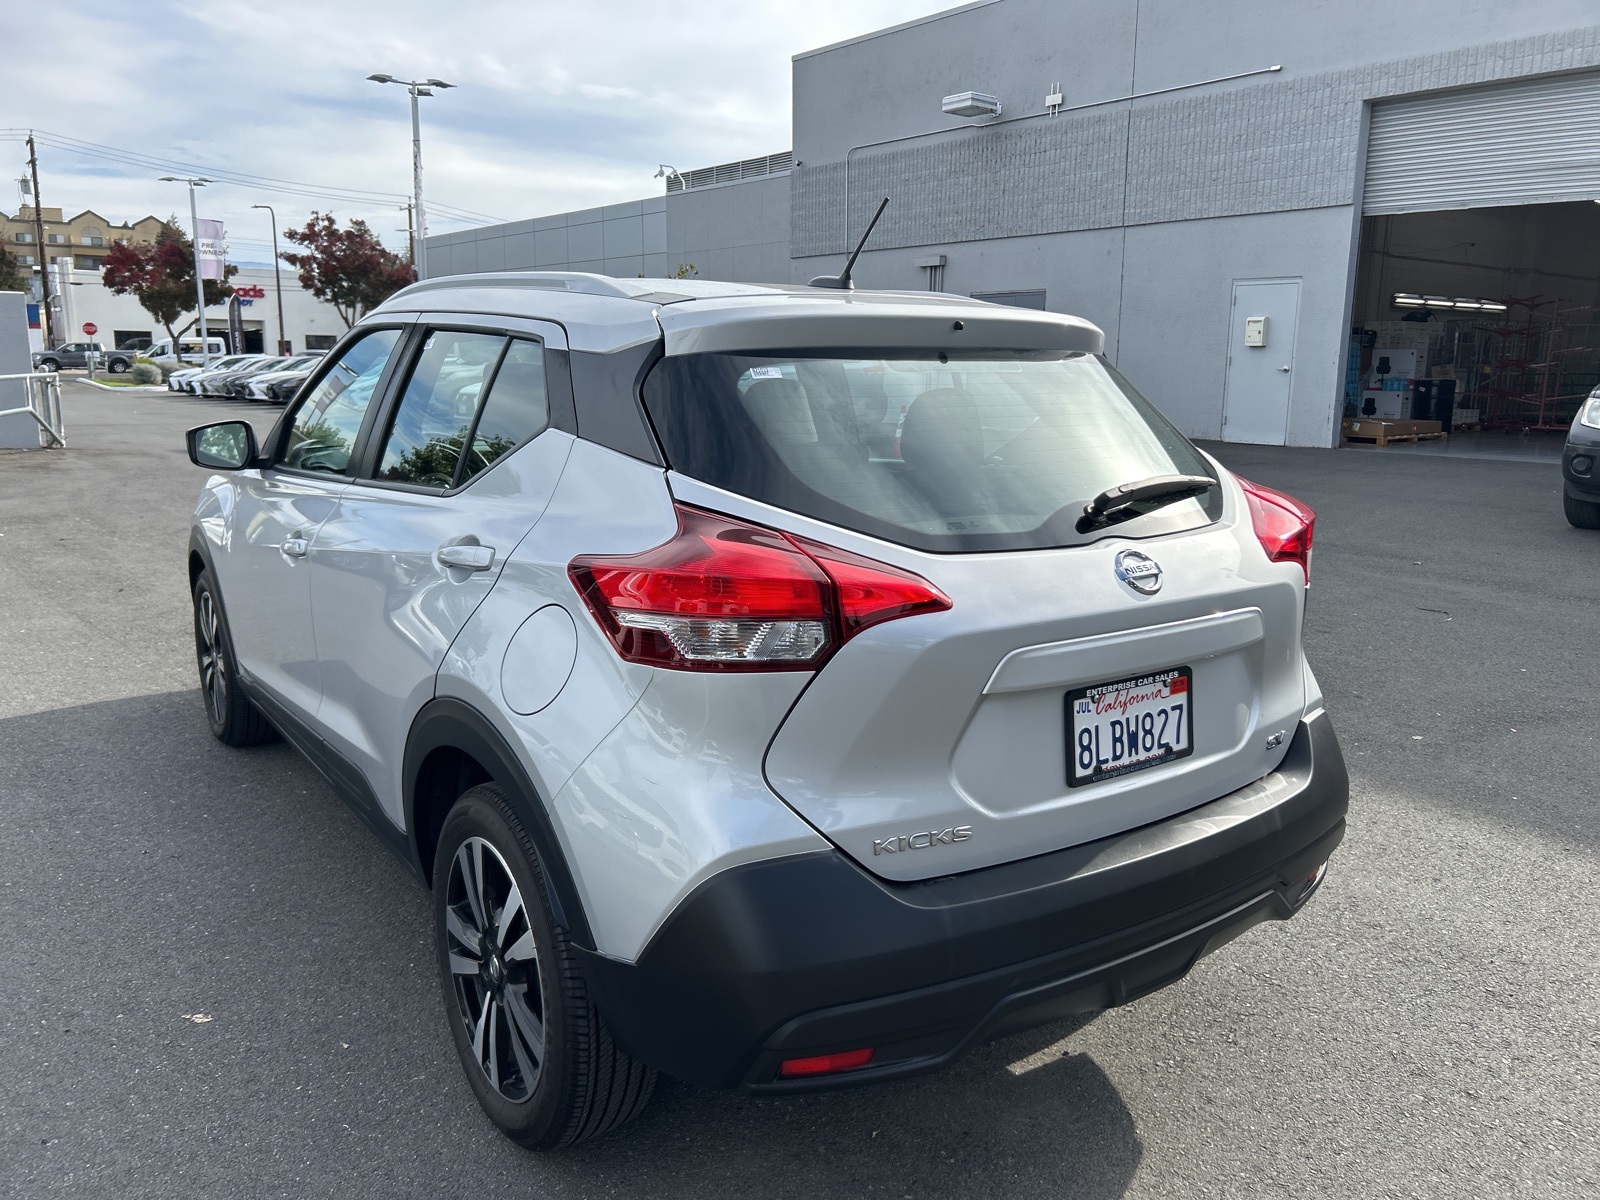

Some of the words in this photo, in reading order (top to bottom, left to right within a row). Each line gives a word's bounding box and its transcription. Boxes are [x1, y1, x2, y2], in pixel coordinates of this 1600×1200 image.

[234, 285, 265, 298] ads
[1086, 682, 1136, 697] ENTERPRISE
[1137, 677, 1153, 686] CAR
[1154, 671, 1179, 682] SALES
[1076, 700, 1091, 714] JUL
[1095, 688, 1171, 715] California
[1078, 703, 1183, 770] 8LBW827
[873, 825, 972, 856] KICKS
